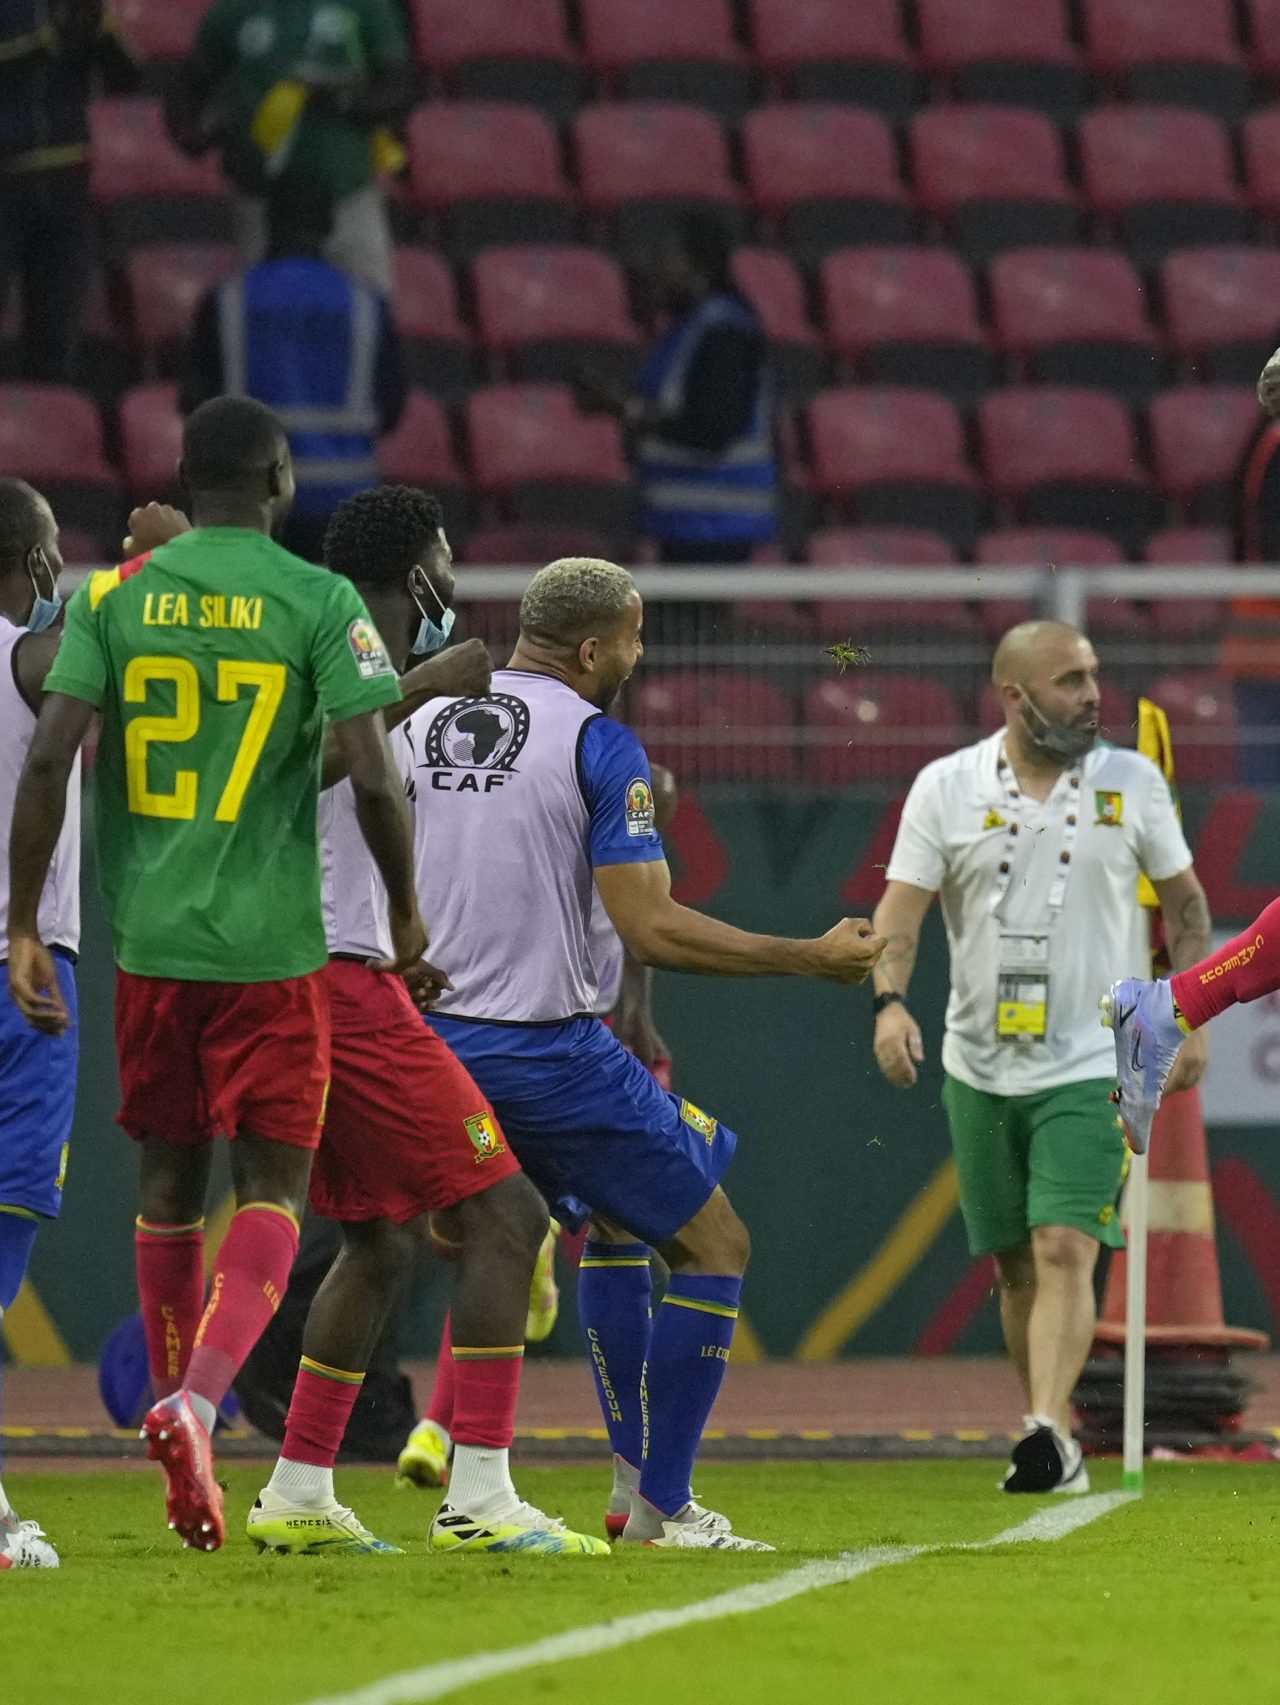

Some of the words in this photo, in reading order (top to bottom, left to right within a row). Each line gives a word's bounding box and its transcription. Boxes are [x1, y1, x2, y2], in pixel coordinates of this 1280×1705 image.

[143, 592, 189, 626] LEA
[200, 594, 263, 629] SILIKI
[123, 655, 287, 823] 27
[431, 771, 505, 793] CAF
[1199, 934, 1265, 985] CAMEROUN
[701, 1345, 716, 1357] LE
[587, 1327, 623, 1423] CAMEROUN
[639, 1360, 649, 1461] CAMEROUN
[286, 1519, 332, 1527] NEMESIS
